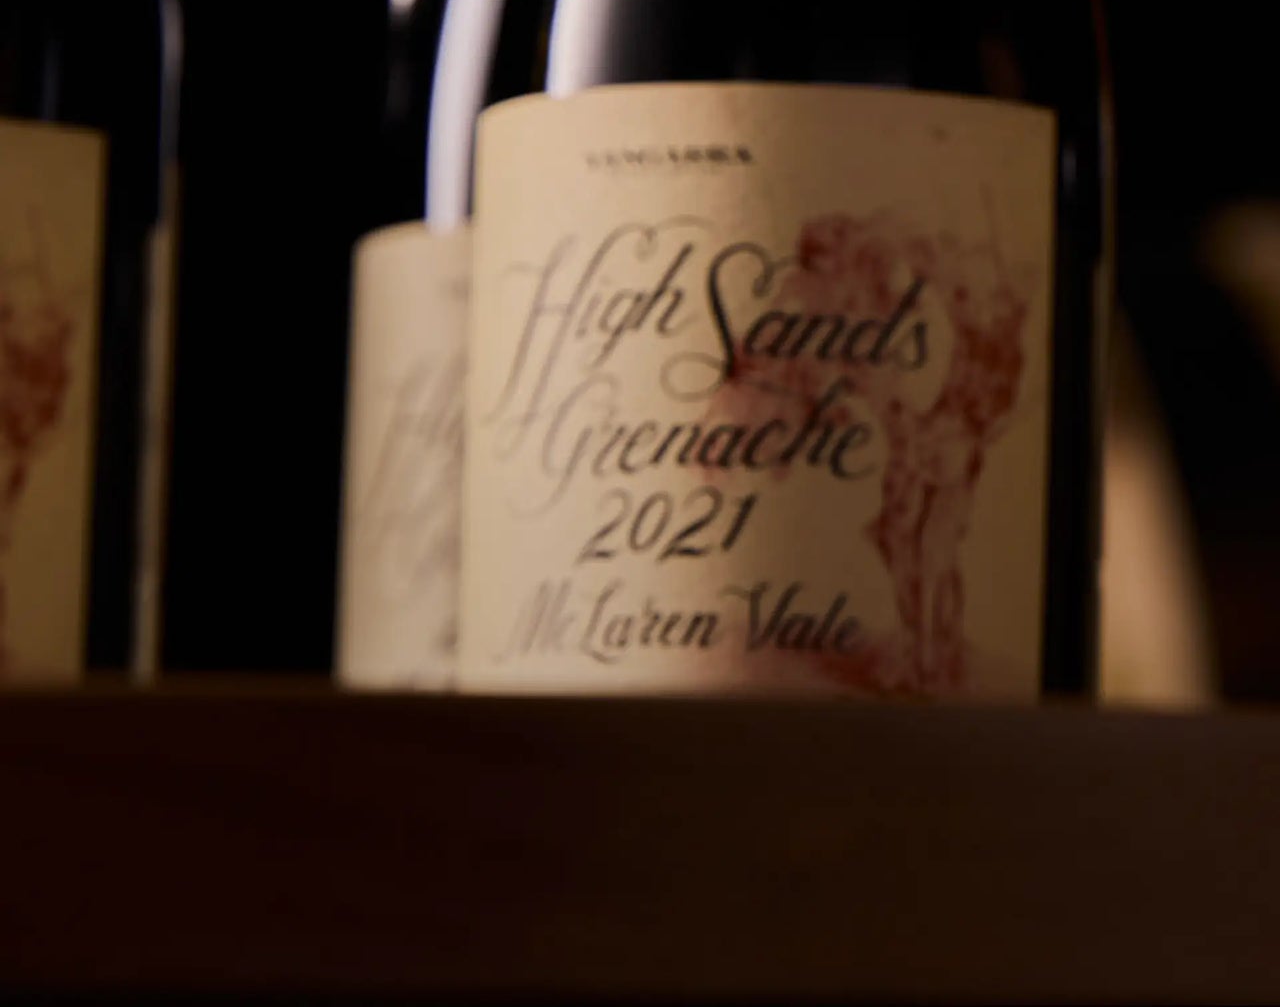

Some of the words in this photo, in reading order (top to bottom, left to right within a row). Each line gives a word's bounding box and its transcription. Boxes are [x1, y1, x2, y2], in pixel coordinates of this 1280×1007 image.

[488, 214, 712, 460] High
[658, 242, 929, 402] Sands
[508, 374, 878, 517] Grenache
[576, 487, 758, 567] 2021
[496, 577, 718, 665] McLaren
[723, 581, 862, 654] Vale
